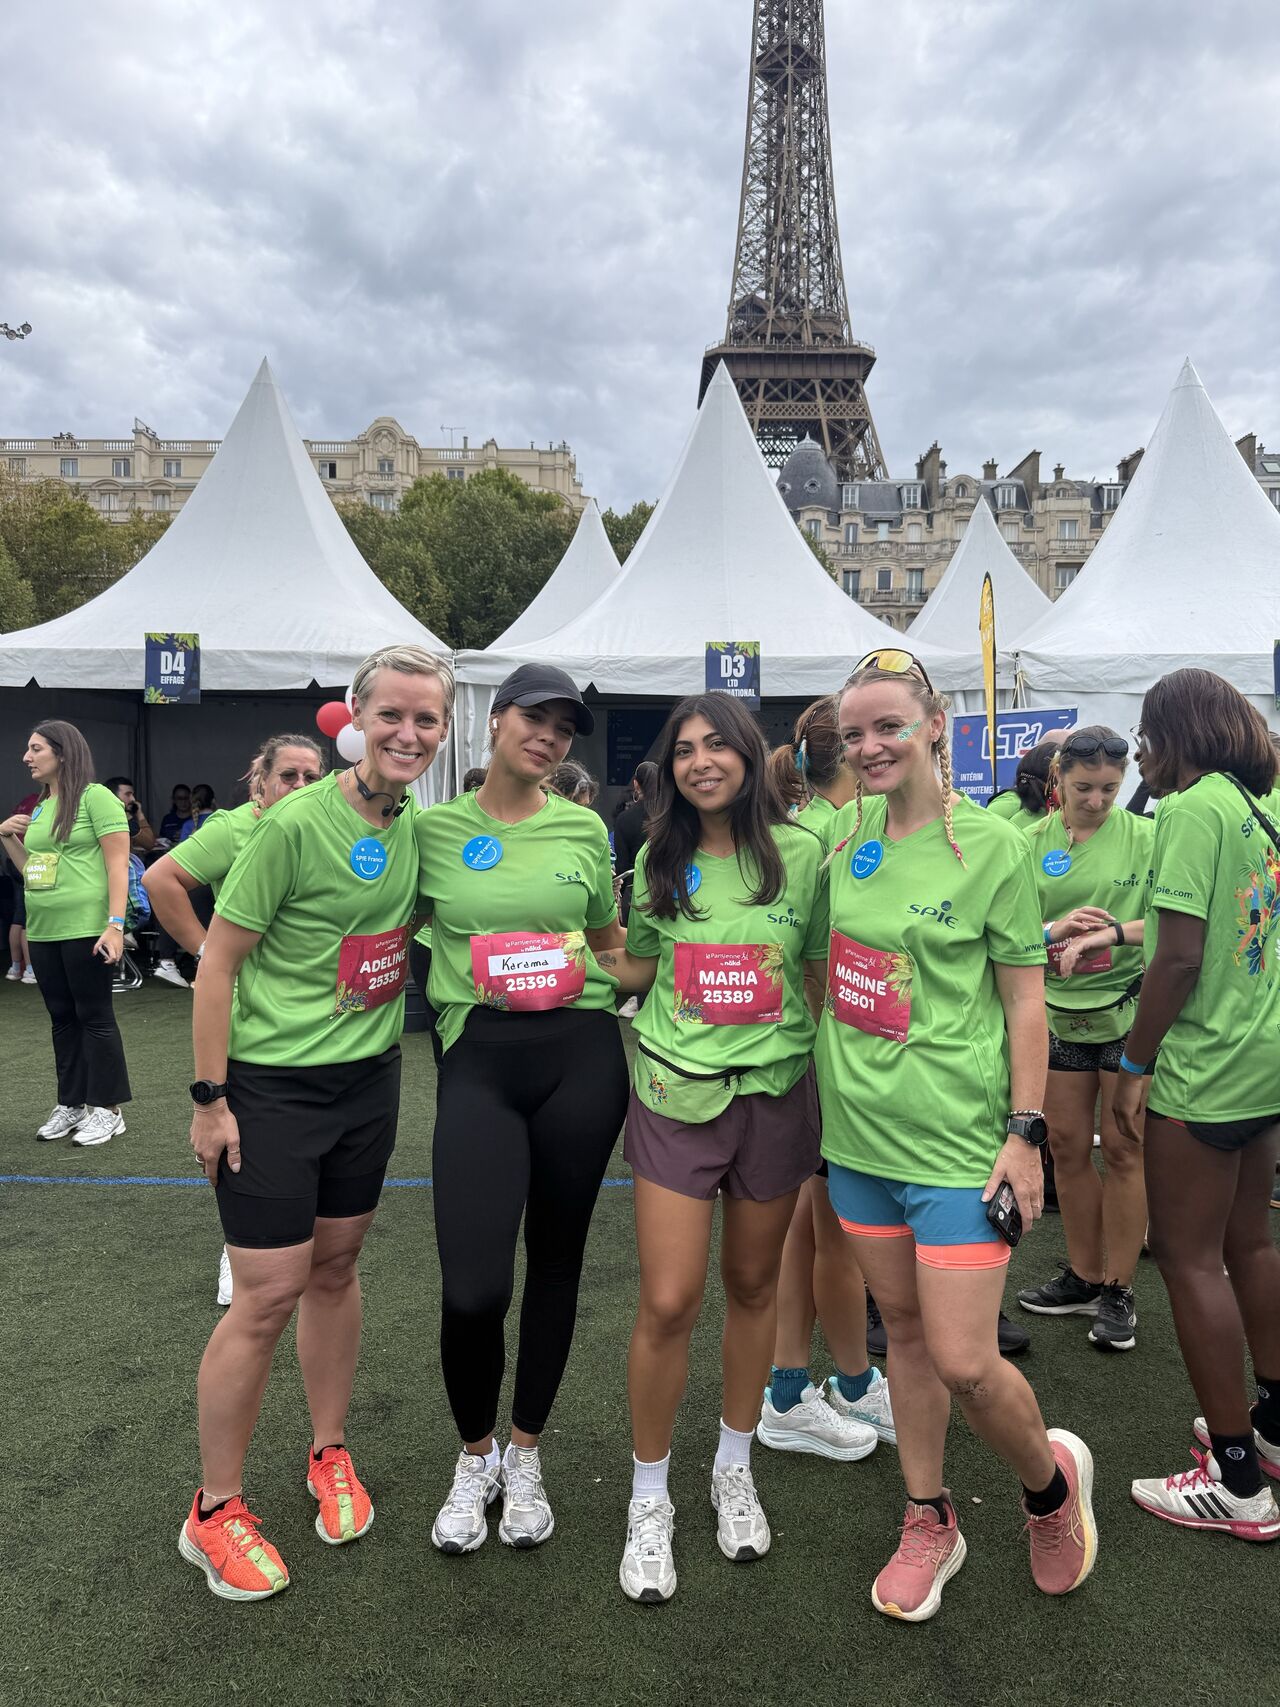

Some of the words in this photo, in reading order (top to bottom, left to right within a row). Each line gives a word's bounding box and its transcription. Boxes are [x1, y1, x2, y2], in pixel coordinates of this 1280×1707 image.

[160, 651, 186, 675] D4
[720, 654, 745, 678] D3
[160, 675, 185, 685] EIFFAGE
[727, 679, 739, 688] LTD
[710, 688, 756, 697] NATIONAL
[960, 771, 984, 781] INTÉRIM
[960, 785, 1001, 795] RECRUTEMET
[355, 854, 368, 862] SPIE
[368, 855, 384, 863] France
[766, 907, 801, 928] SPIE
[906, 900, 959, 930] SPIE
[359, 948, 407, 974] ADELINE
[368, 968, 400, 991] 25336
[506, 974, 558, 992] 25396
[699, 970, 758, 986] MARIA
[835, 962, 887, 996] MARINE
[702, 989, 754, 1004] 25389
[838, 985, 875, 1012] 25501
